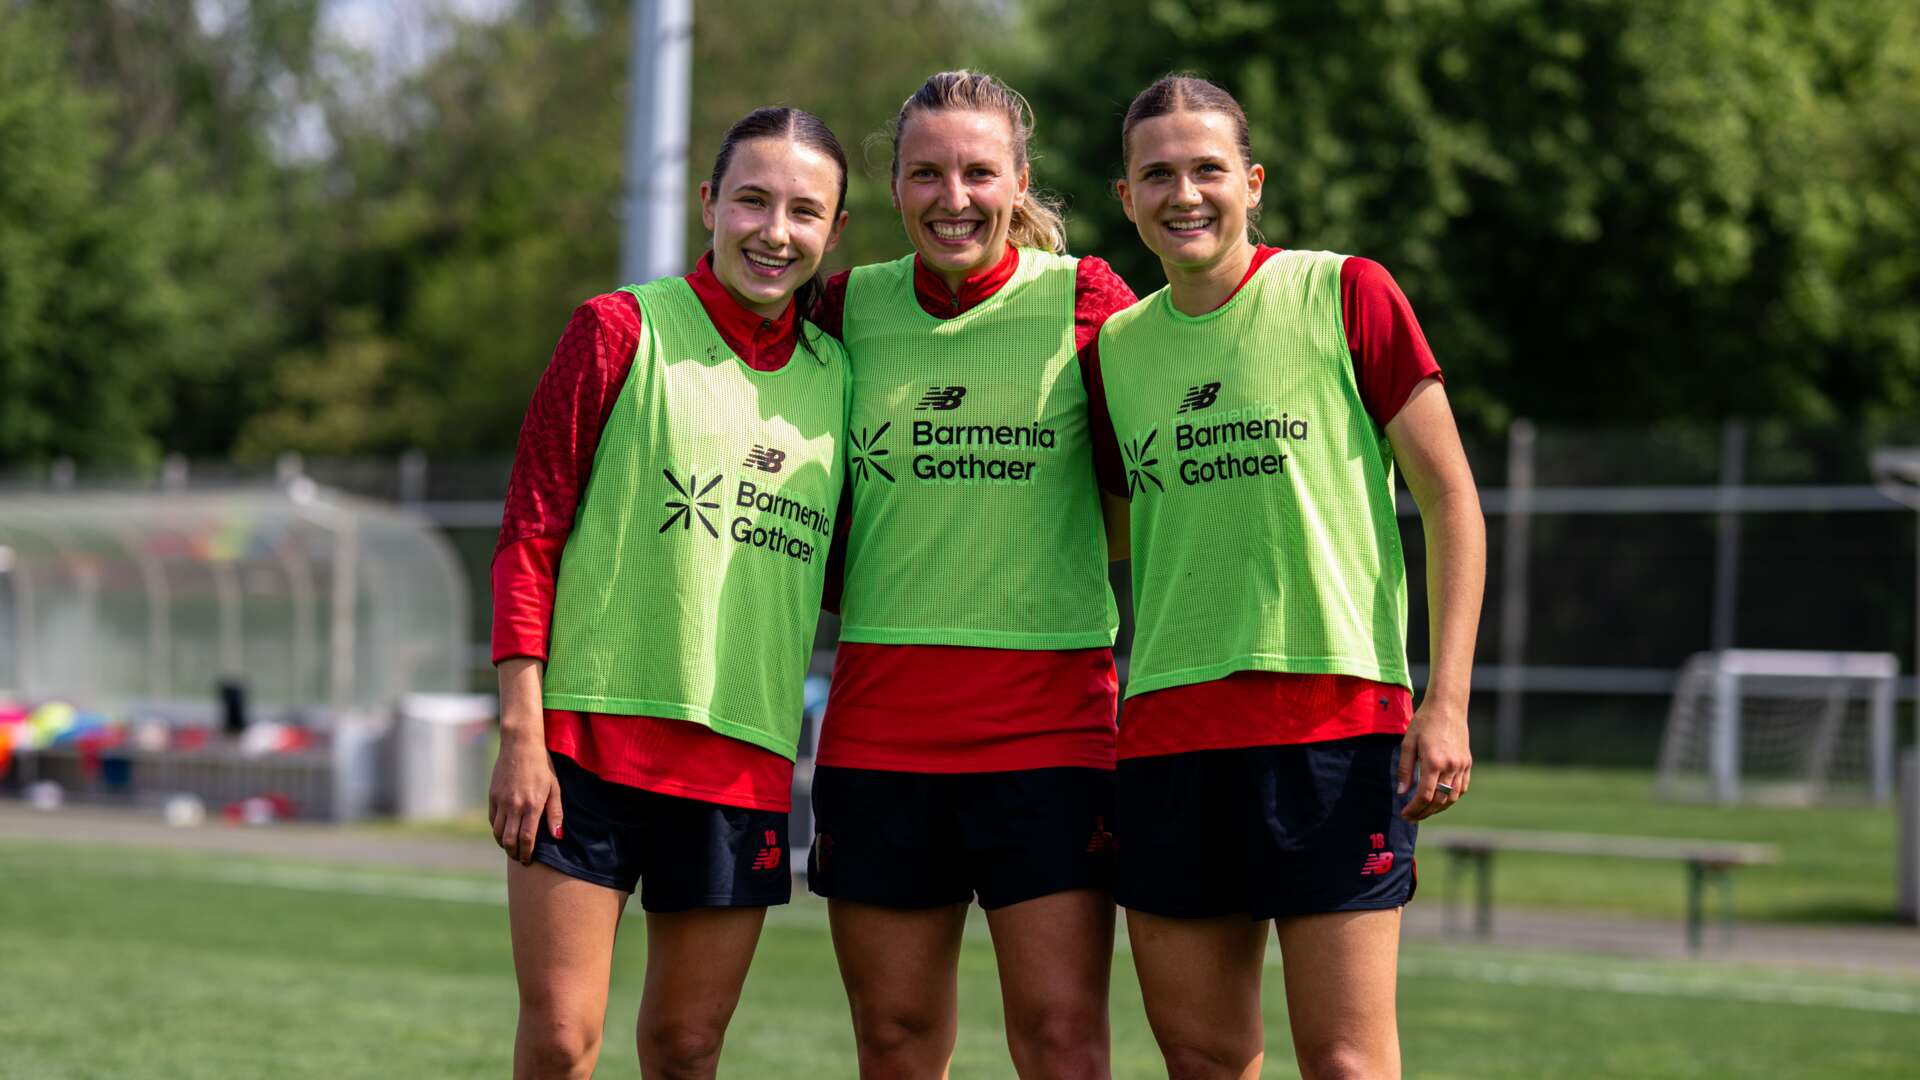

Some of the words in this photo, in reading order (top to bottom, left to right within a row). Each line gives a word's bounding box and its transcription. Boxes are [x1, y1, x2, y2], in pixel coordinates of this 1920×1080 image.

[912, 420, 1055, 447] Barmenia
[1176, 413, 1308, 451] Barmenia
[912, 454, 1036, 480] Gothaer
[1179, 453, 1287, 486] Gothaer
[736, 480, 830, 536] Barmenia
[730, 516, 814, 564] Gothaer
[1369, 833, 1385, 849] 18
